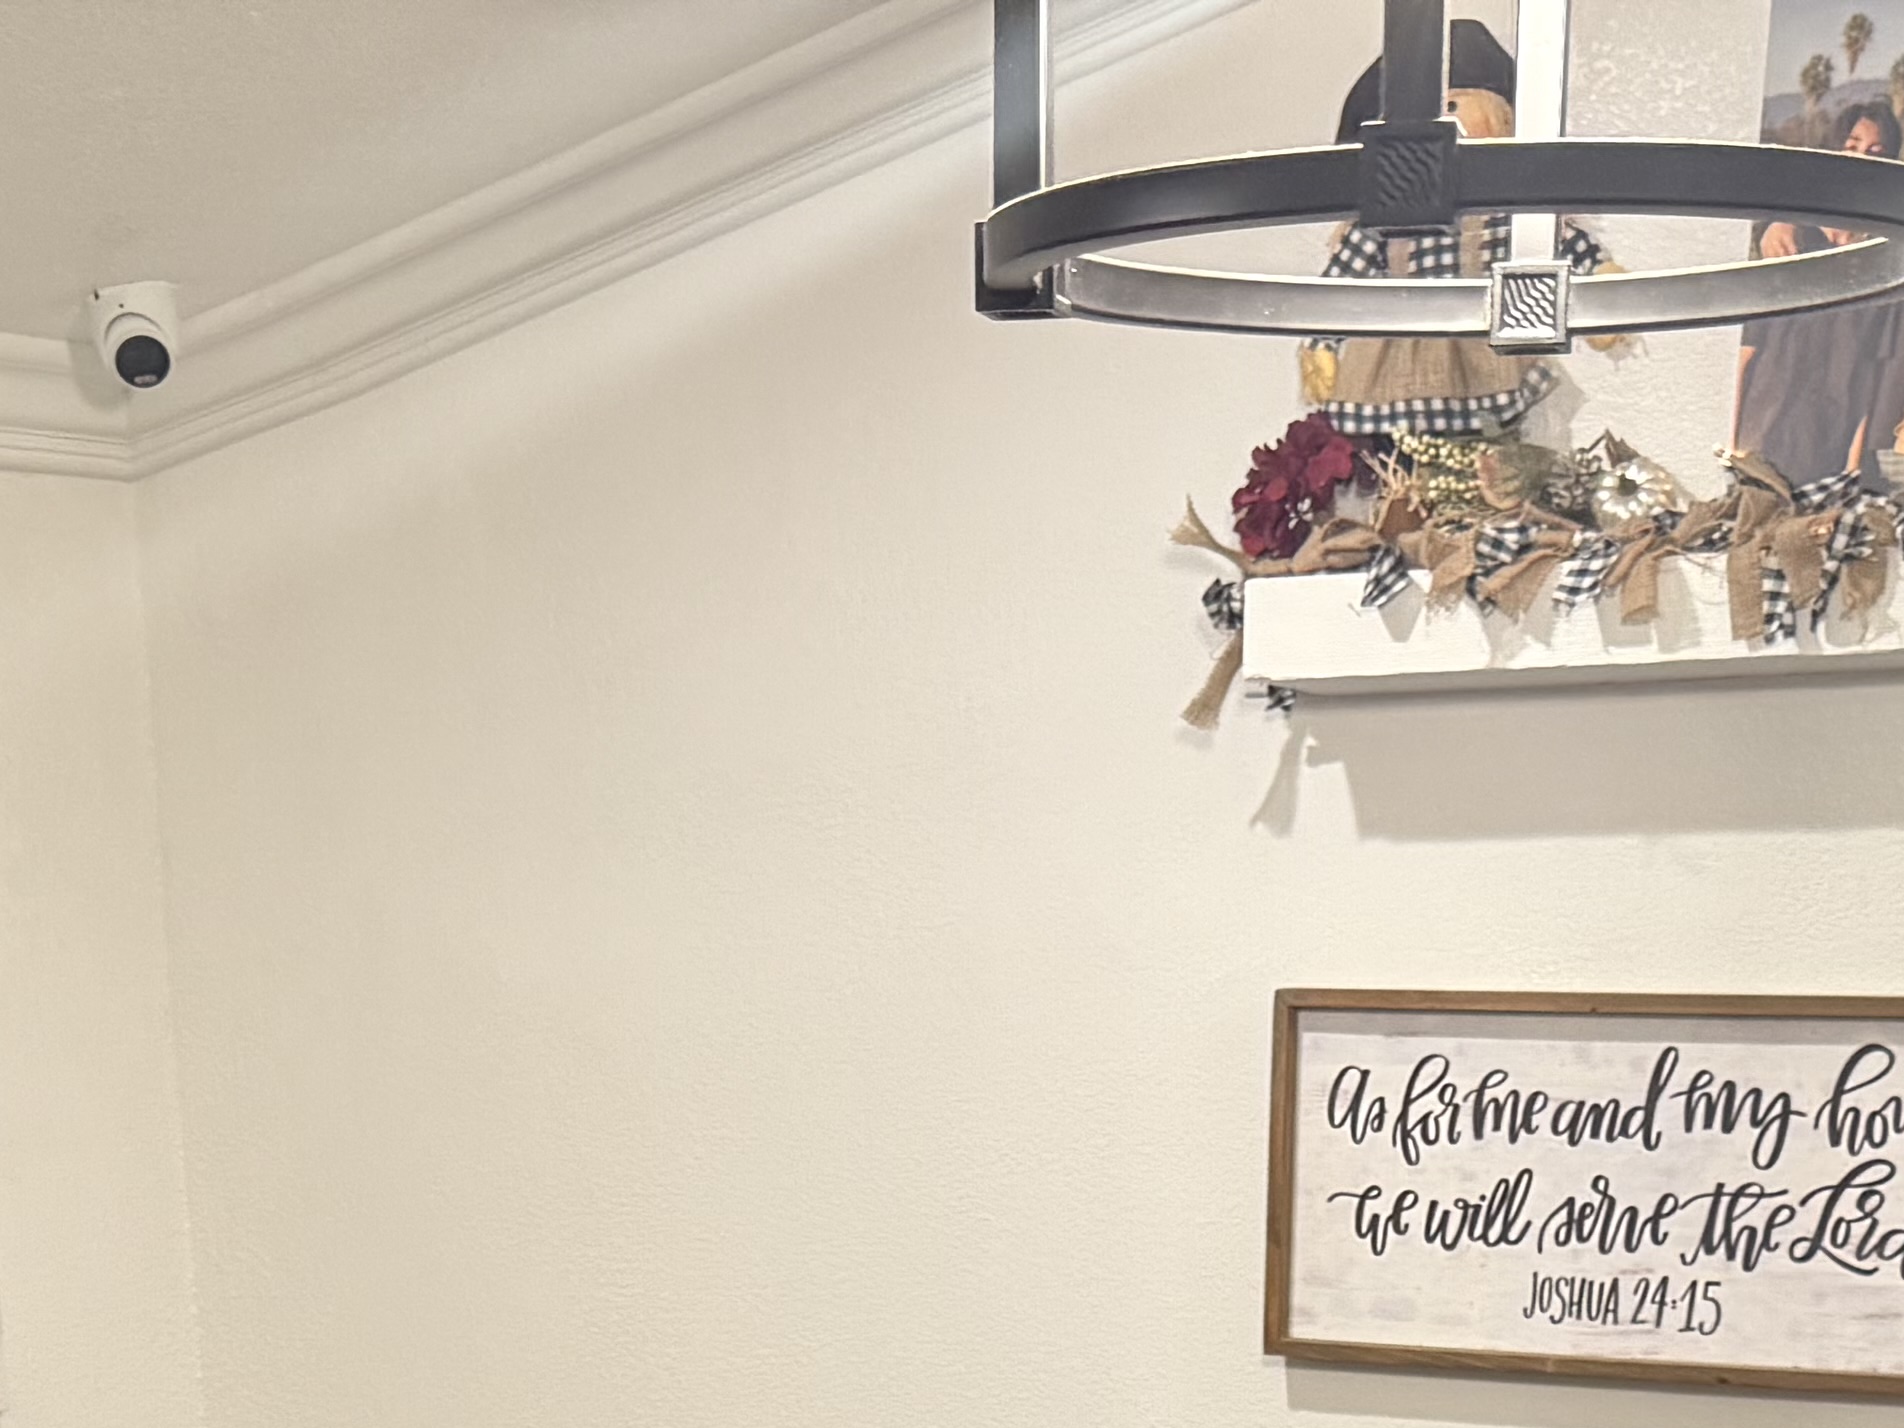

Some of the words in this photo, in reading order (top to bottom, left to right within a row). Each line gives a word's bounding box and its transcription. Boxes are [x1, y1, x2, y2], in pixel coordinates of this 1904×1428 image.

[1327, 1065, 1387, 1144] As
[1391, 1053, 1463, 1166] for
[1463, 1068, 1550, 1140] me
[1551, 1046, 1681, 1152] and
[1671, 1068, 1808, 1170] my
[1327, 1182, 1428, 1257] we
[1424, 1168, 1533, 1252] will
[1536, 1174, 1679, 1256] serve
[1678, 1180, 1796, 1274] the
[1523, 1272, 1620, 1327] JOSHUA
[1631, 1276, 1723, 1335] 24:15
